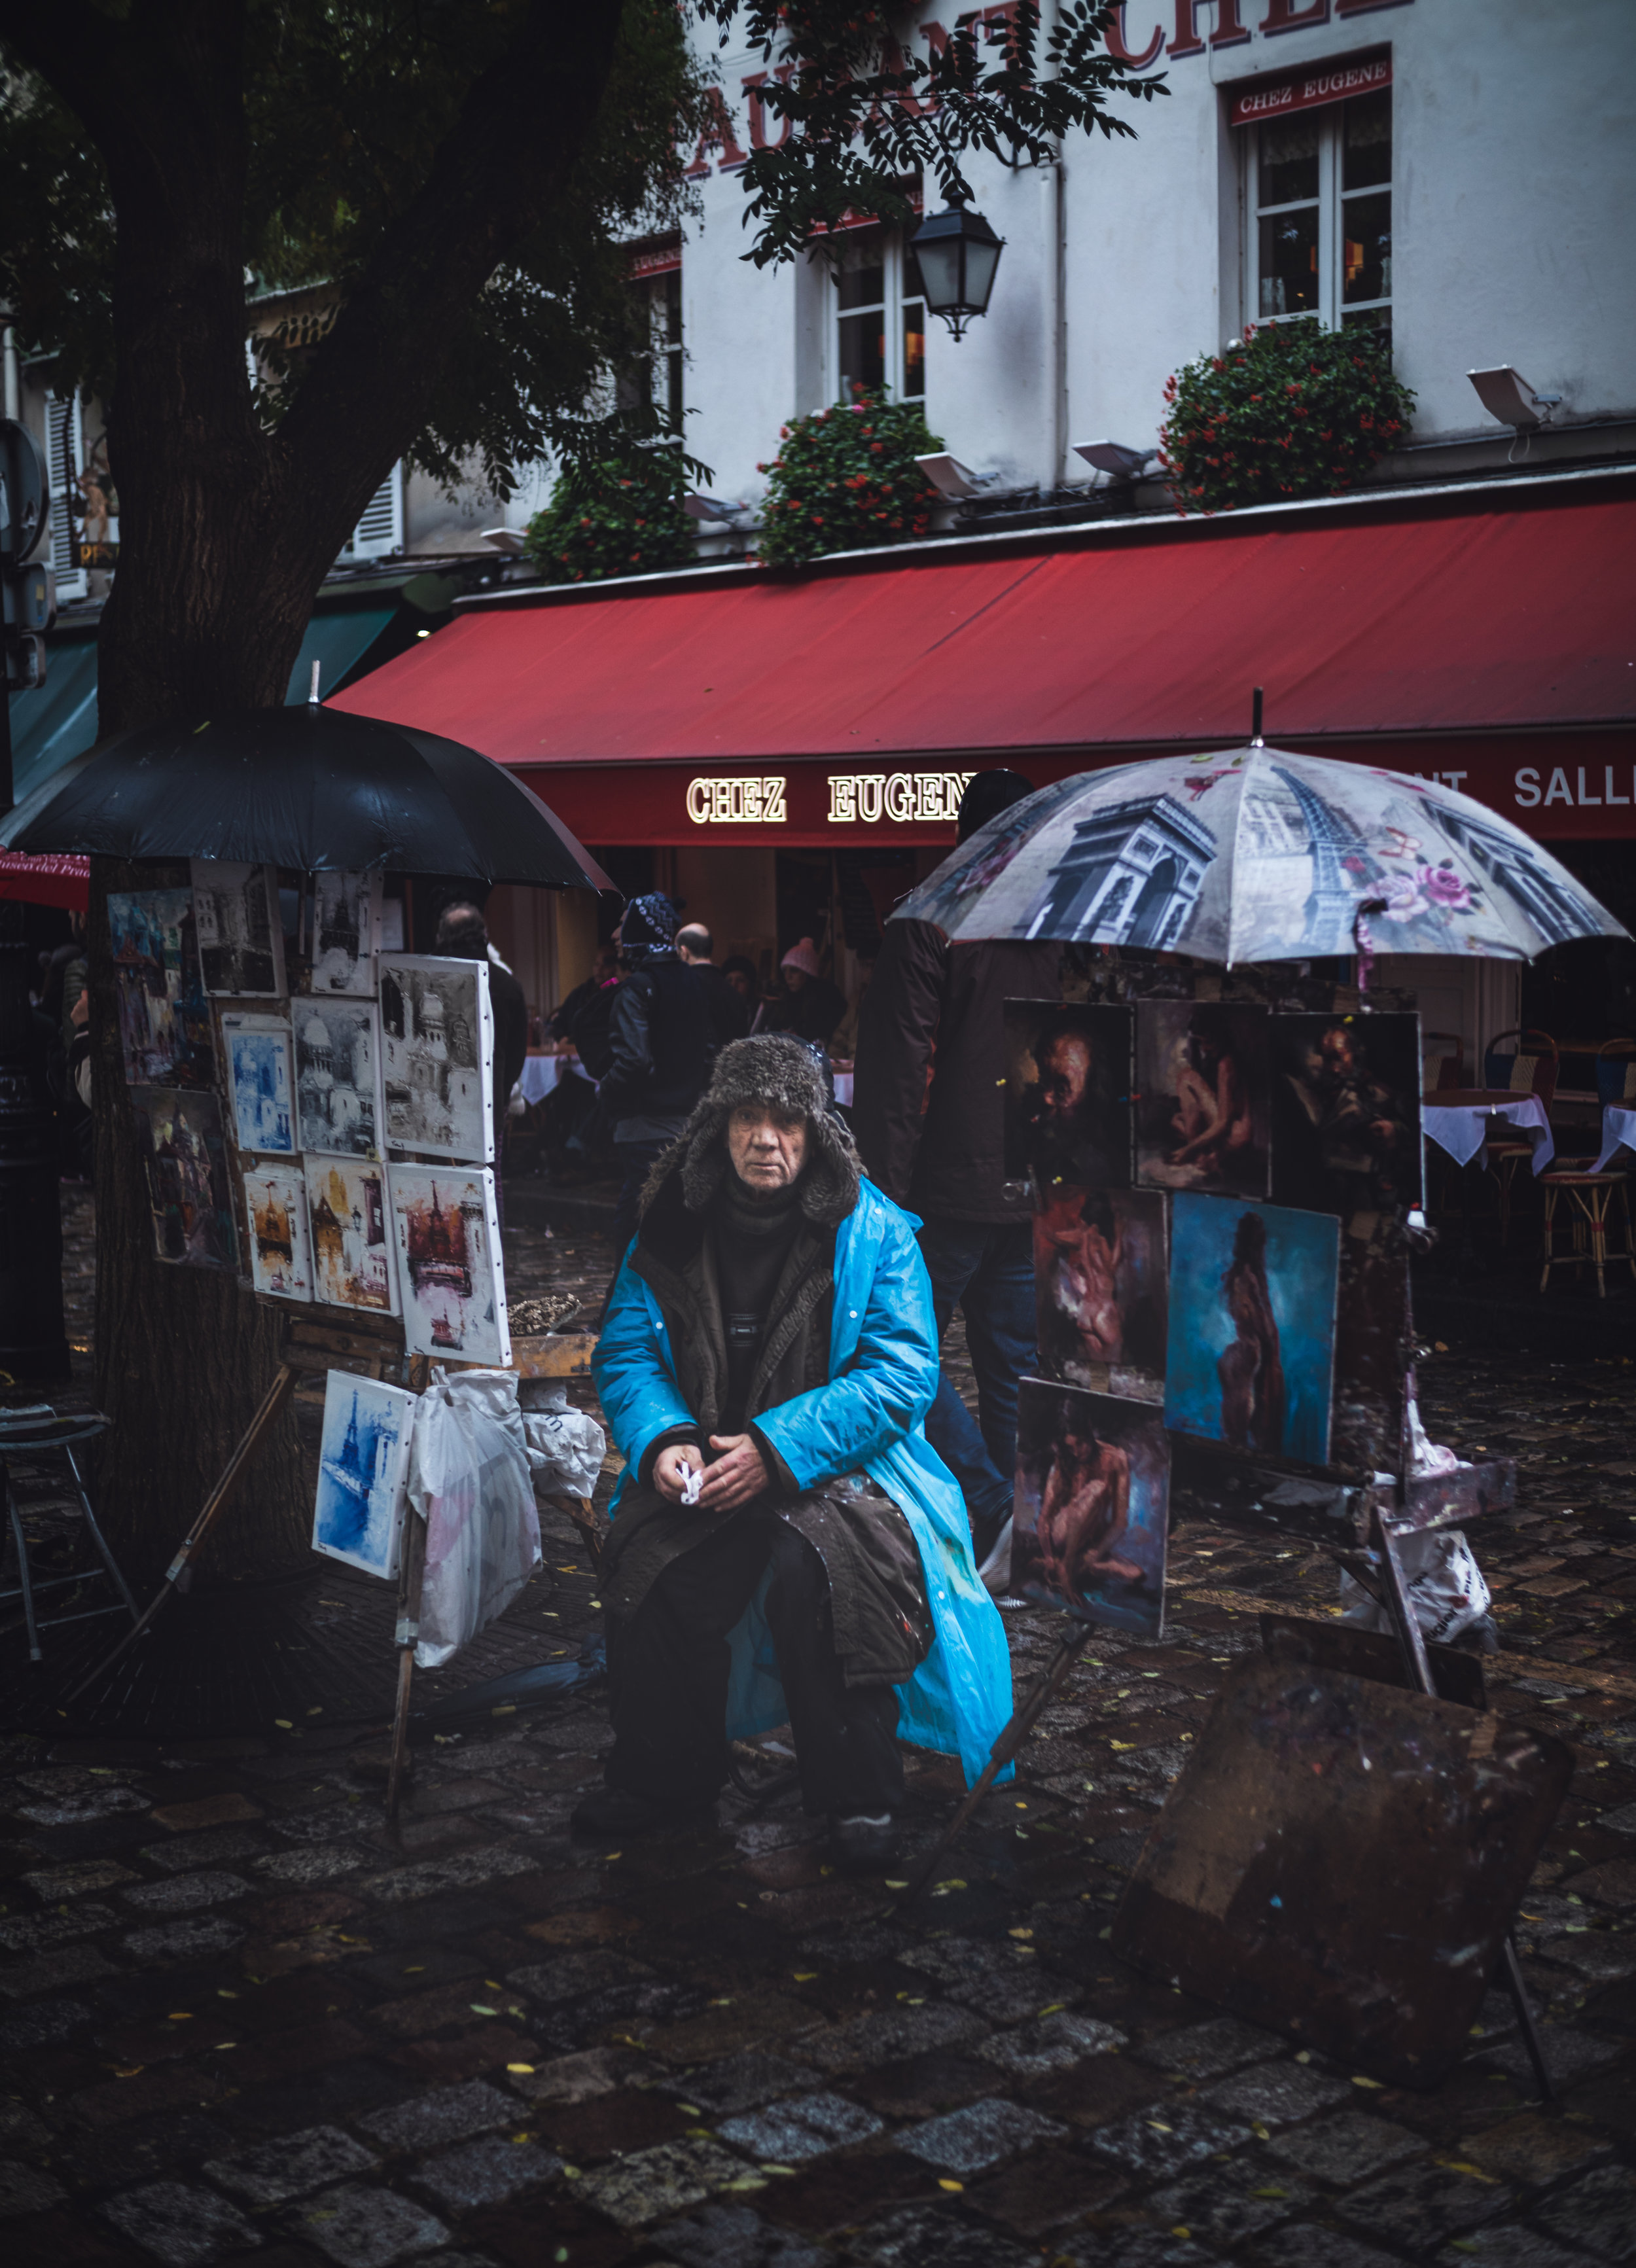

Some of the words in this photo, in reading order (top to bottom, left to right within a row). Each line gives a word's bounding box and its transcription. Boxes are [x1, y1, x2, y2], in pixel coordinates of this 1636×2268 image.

[1239, 86, 1292, 114] CHEZ
[1303, 61, 1387, 98] EUGENE
[686, 777, 787, 824] CHEZ
[1514, 766, 1636, 807] SALL
